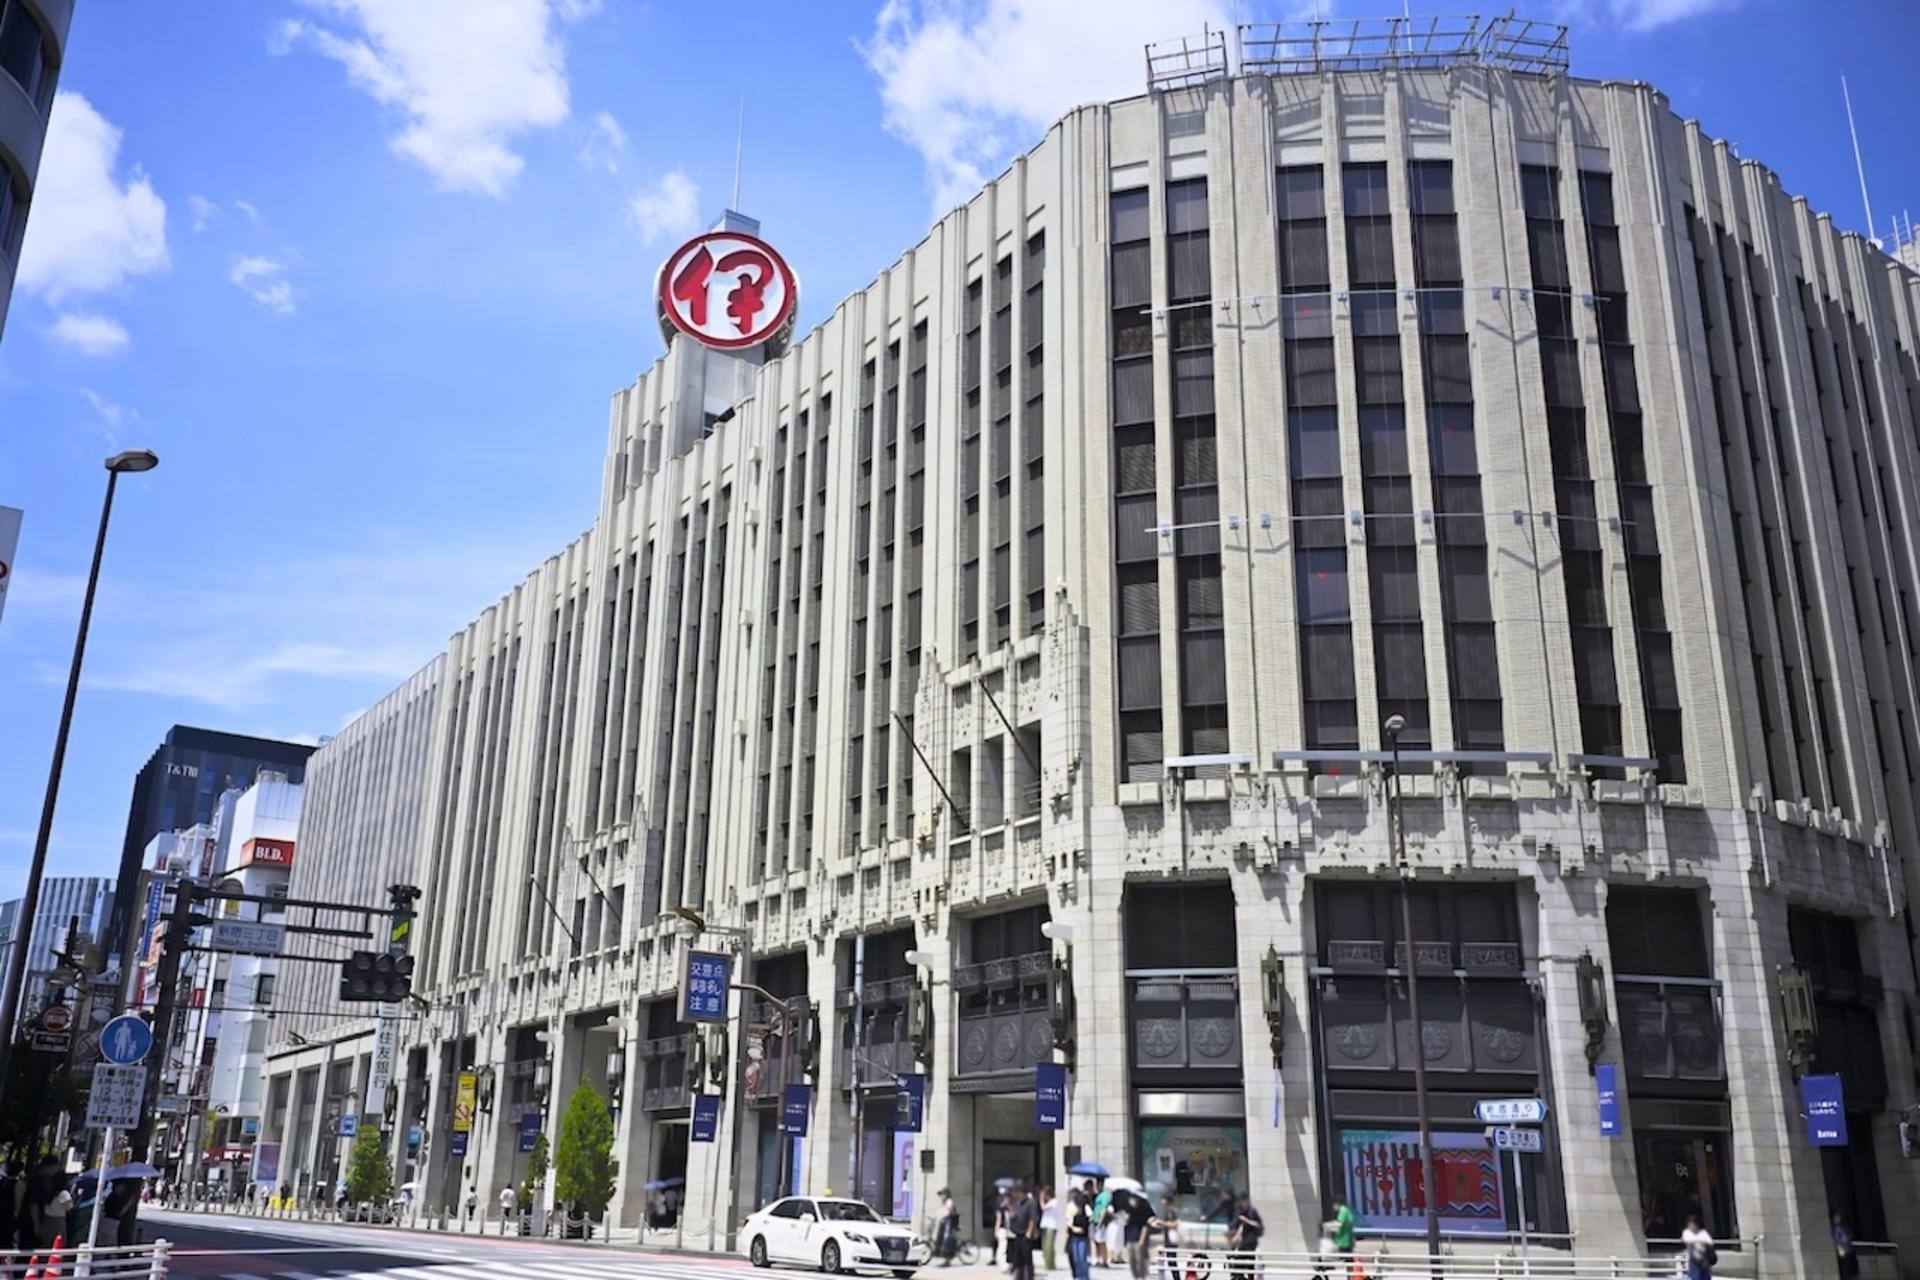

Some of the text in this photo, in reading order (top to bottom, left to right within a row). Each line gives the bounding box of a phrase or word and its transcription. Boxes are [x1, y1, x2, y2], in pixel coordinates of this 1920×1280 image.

[218, 925, 279, 942] 新宿三丁目
[691, 962, 723, 978] 交差点
[690, 979, 722, 996] 事故多し
[689, 996, 720, 1013] 注意
[374, 1006, 396, 1089] 三井住友銀行
